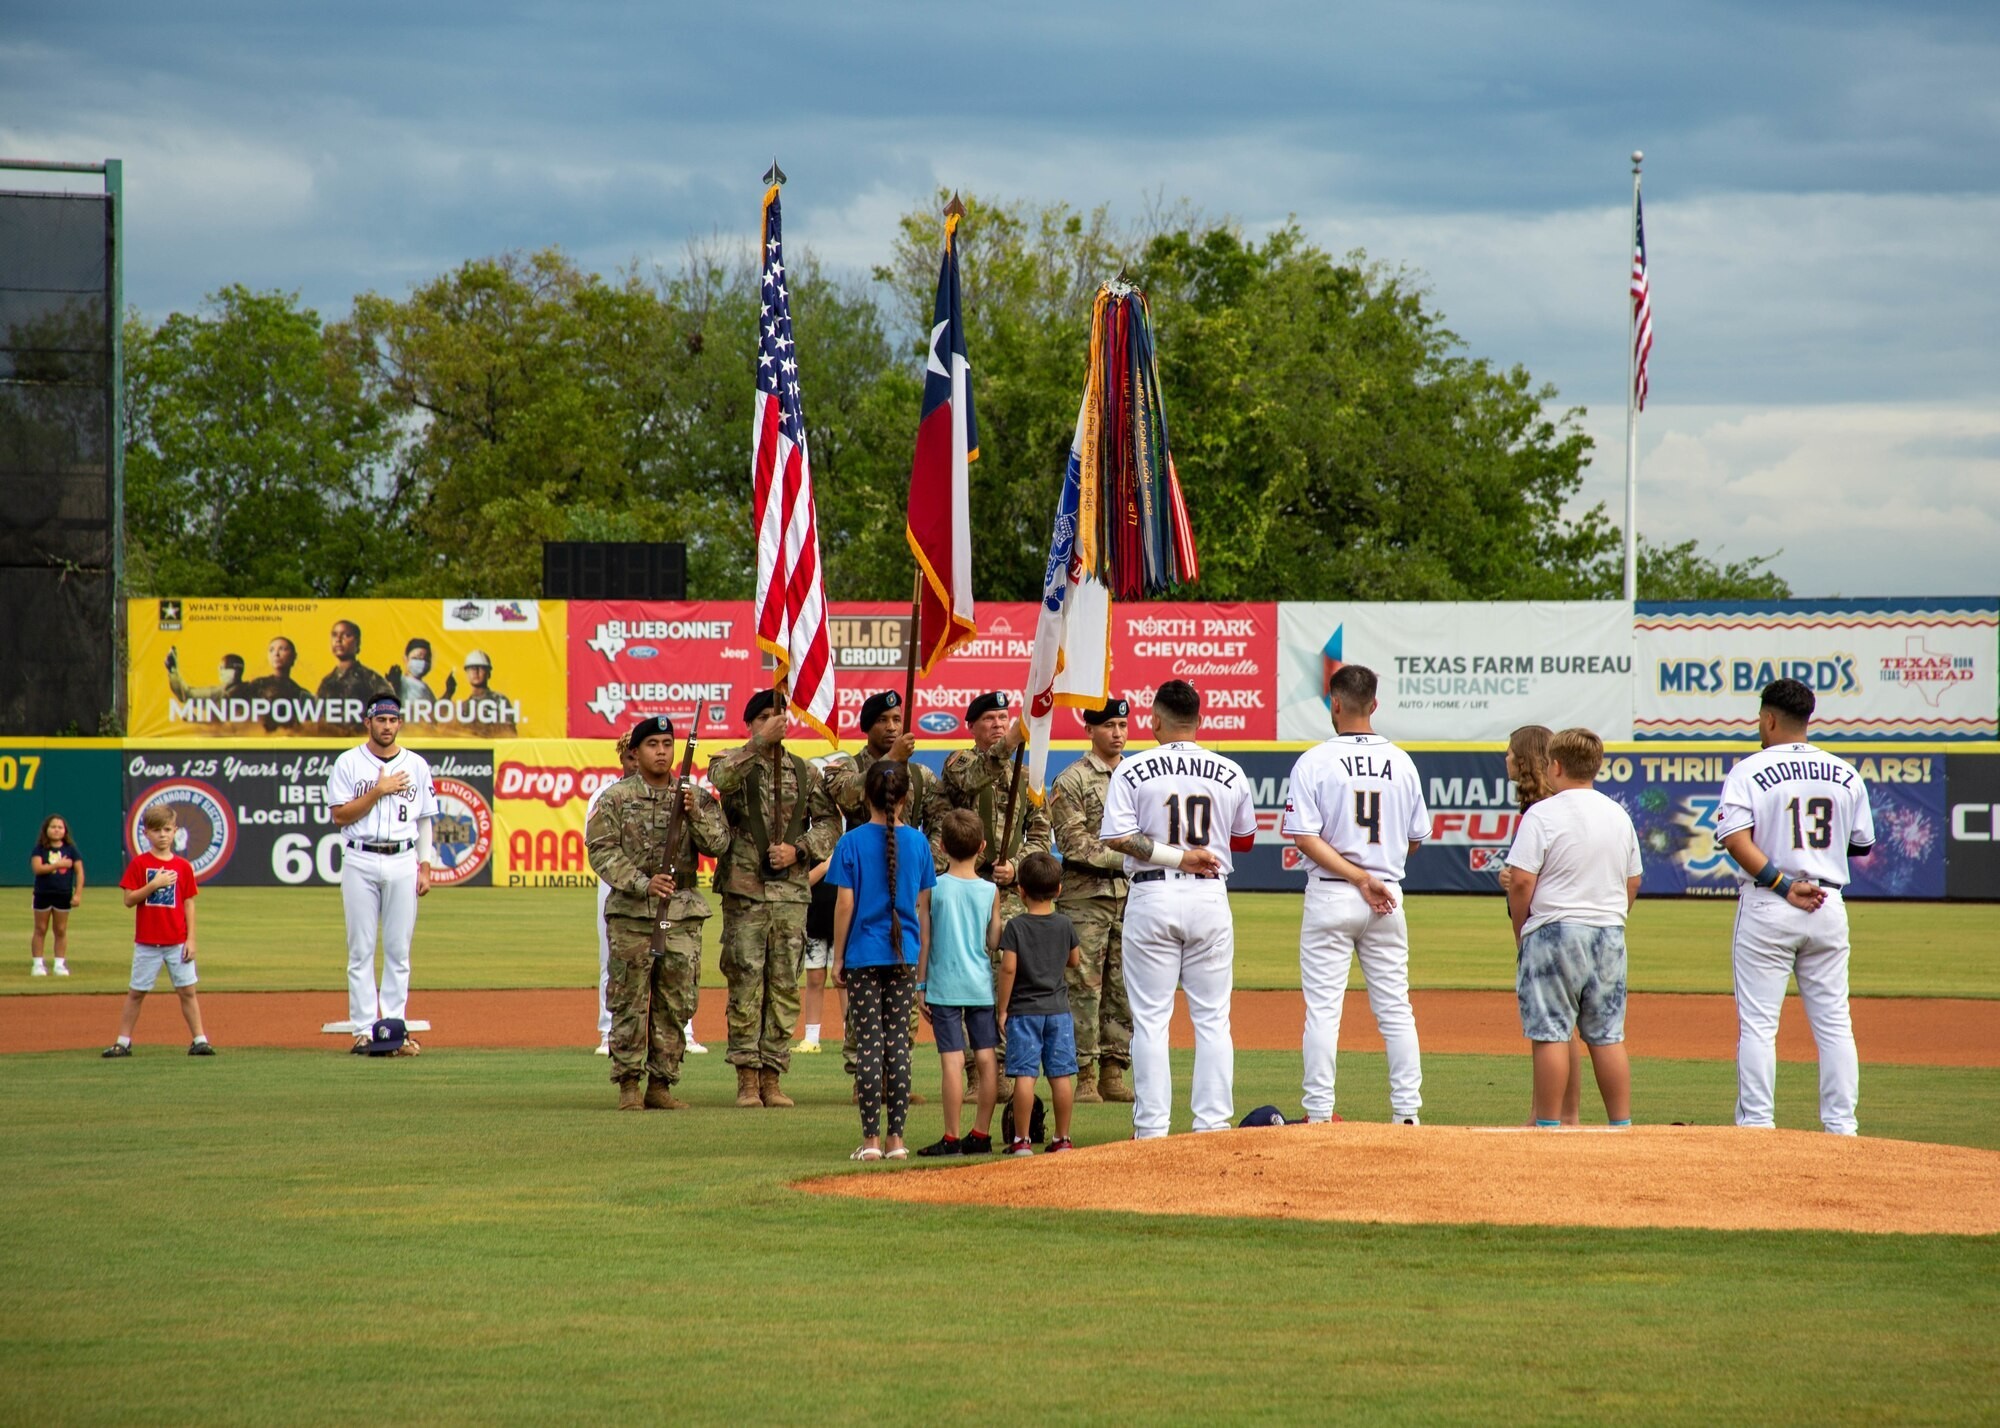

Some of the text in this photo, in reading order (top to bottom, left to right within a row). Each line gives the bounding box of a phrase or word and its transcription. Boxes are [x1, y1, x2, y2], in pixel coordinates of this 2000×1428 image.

[1085, 416, 1097, 480] PHILIPPINES
[1139, 420, 1150, 484] DONELSON
[1084, 487, 1094, 512] 1945
[189, 603, 318, 612] WHAT'S YOUR WARRIOR?
[608, 621, 732, 639] BLUEBONNET
[829, 621, 901, 647] HLIG
[1127, 615, 1255, 637] NORTH PARK
[720, 647, 749, 660] Jeep
[841, 648, 901, 665] GROUP
[1007, 639, 1036, 656] PAR
[1134, 642, 1247, 657] CHEVROLET
[1172, 659, 1259, 675] Castroville
[1395, 656, 1632, 673] TEXAS FARM BUREAU
[1880, 657, 1951, 668] TEXAS
[1659, 660, 1722, 692] MRS
[1903, 669, 1974, 681] BREAD
[608, 683, 732, 701] BLUEBONNET
[1398, 677, 1529, 695] INSURANCE
[1205, 690, 1264, 708] PARK
[1398, 701, 1423, 709] AUTO
[1433, 701, 1460, 709] HOME
[1470, 701, 1488, 709] LIFE
[168, 699, 528, 723] MINDPOWER HROUGH.
[129, 756, 175, 776] Over
[181, 759, 218, 776] 125
[223, 756, 278, 782] Years
[282, 756, 302, 783] of
[1122, 756, 1237, 789] FERNANDEZ
[1340, 756, 1392, 780] VELA
[1752, 761, 1854, 791] RODRIGUEZ
[502, 767, 573, 801] Drop
[238, 806, 305, 824] Local
[398, 804, 408, 822] 8
[441, 781, 481, 808] UNION
[477, 836, 489, 853] 60
[1163, 794, 1212, 847] 10
[1354, 790, 1381, 844] 4
[1785, 797, 1834, 850] 13
[509, 830, 584, 872] AAA
[509, 875, 599, 887] PLUMBIN
